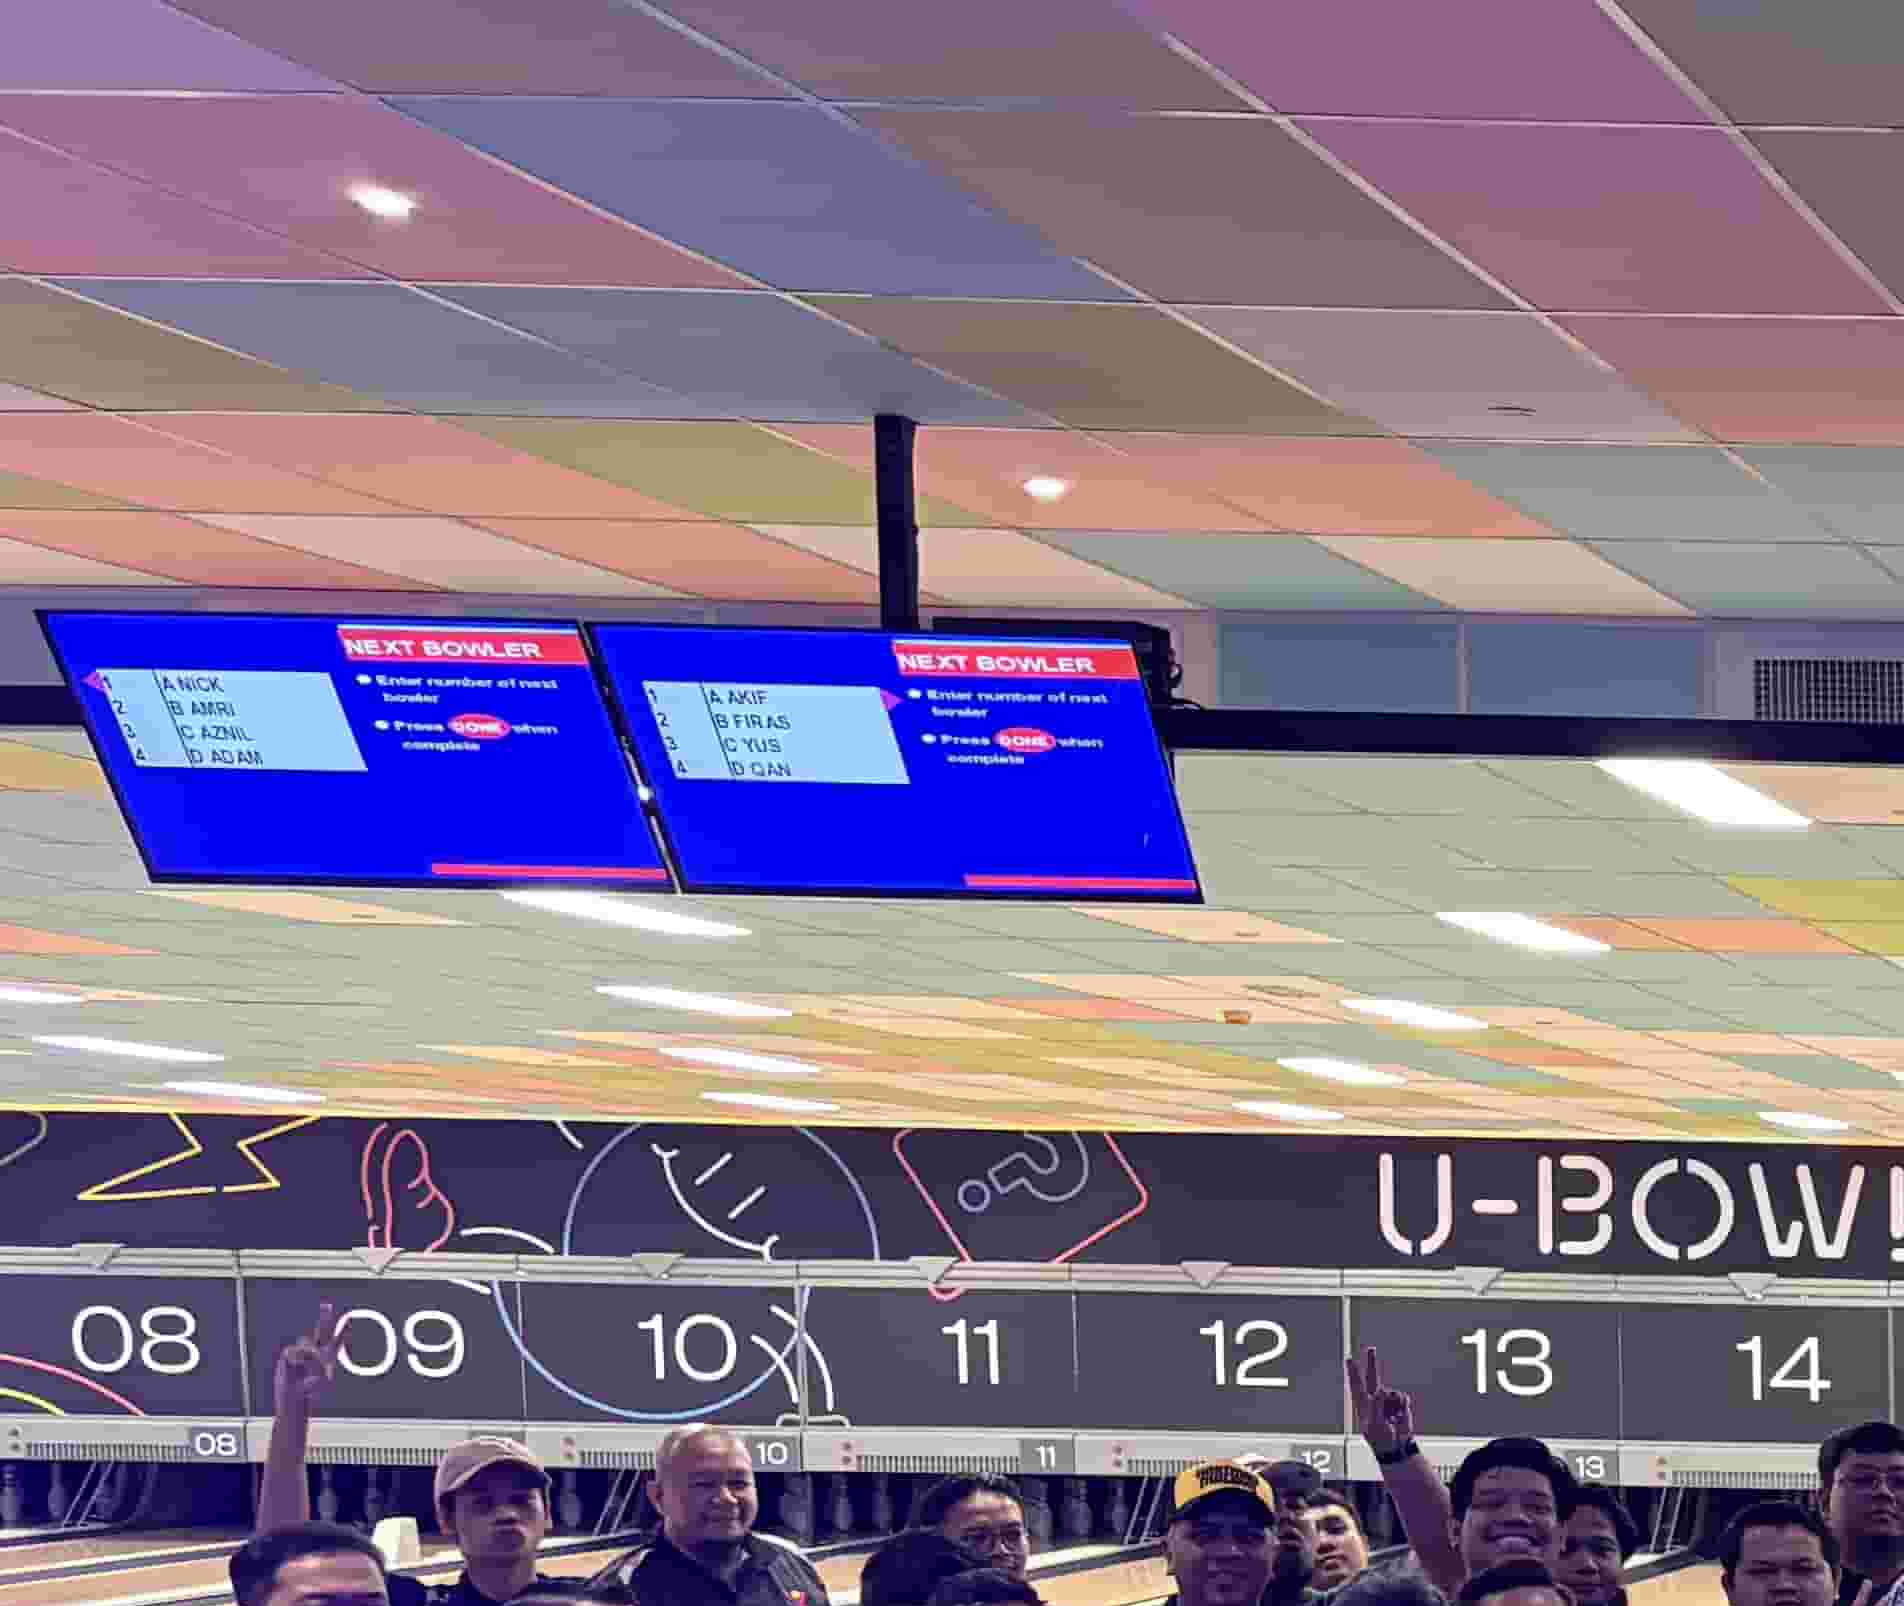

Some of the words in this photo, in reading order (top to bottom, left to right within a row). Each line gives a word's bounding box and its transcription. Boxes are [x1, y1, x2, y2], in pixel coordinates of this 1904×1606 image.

[349, 640, 416, 656] NEXT
[422, 641, 544, 657] BOWLER
[899, 655, 968, 671] NEXT
[976, 656, 1096, 673] BOWLER
[180, 676, 224, 692] NICK
[728, 690, 768, 705] AKIF
[735, 714, 791, 730] FIRAS
[201, 726, 255, 741] AZNIL
[740, 738, 781, 753] YUS
[212, 749, 264, 765] ADAM
[71, 1305, 201, 1374] 08
[335, 1309, 464, 1377] 09
[637, 1313, 737, 1381] 10
[942, 1319, 1000, 1385] 11
[1200, 1319, 1289, 1387] 12
[1461, 1328, 1554, 1396] 13
[1736, 1335, 1831, 1401] 14
[195, 1434, 238, 1456] 08
[756, 1442, 787, 1465] 10
[1036, 1446, 1057, 1468] 11
[1575, 1456, 1605, 1478] 13
